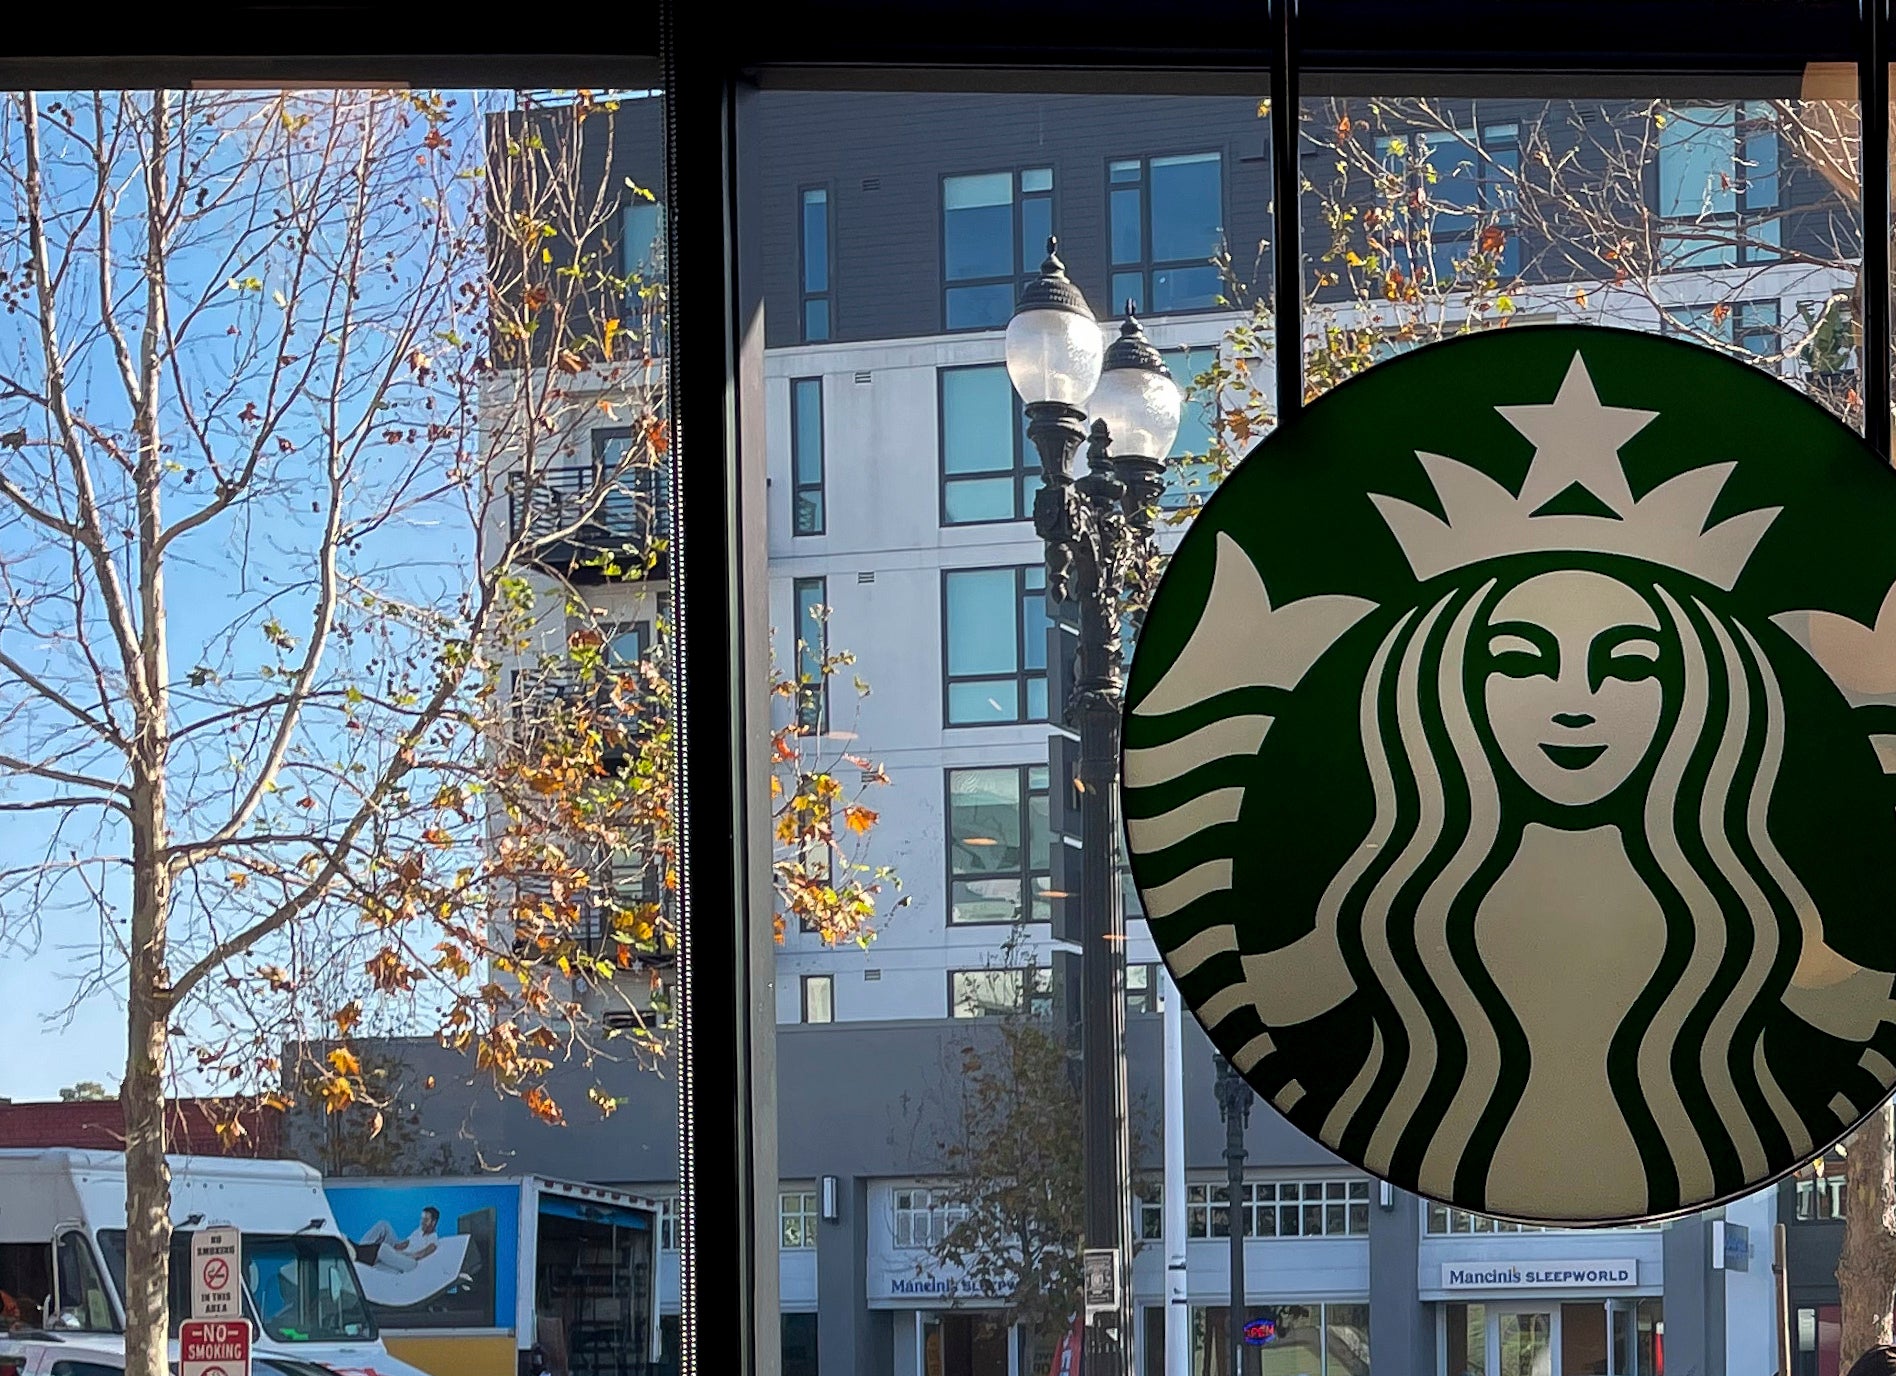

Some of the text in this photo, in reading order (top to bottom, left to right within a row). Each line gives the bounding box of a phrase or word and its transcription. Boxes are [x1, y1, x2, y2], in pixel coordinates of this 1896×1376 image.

[211, 1235, 222, 1244] NO
[197, 1246, 235, 1256] SMOKING
[1450, 1265, 1629, 1284] Mancini's SLEEPWORLD
[212, 1292, 230, 1302] THIS
[205, 1304, 227, 1313] AREA
[203, 1325, 227, 1342] NO
[188, 1343, 242, 1359] SMOKING
